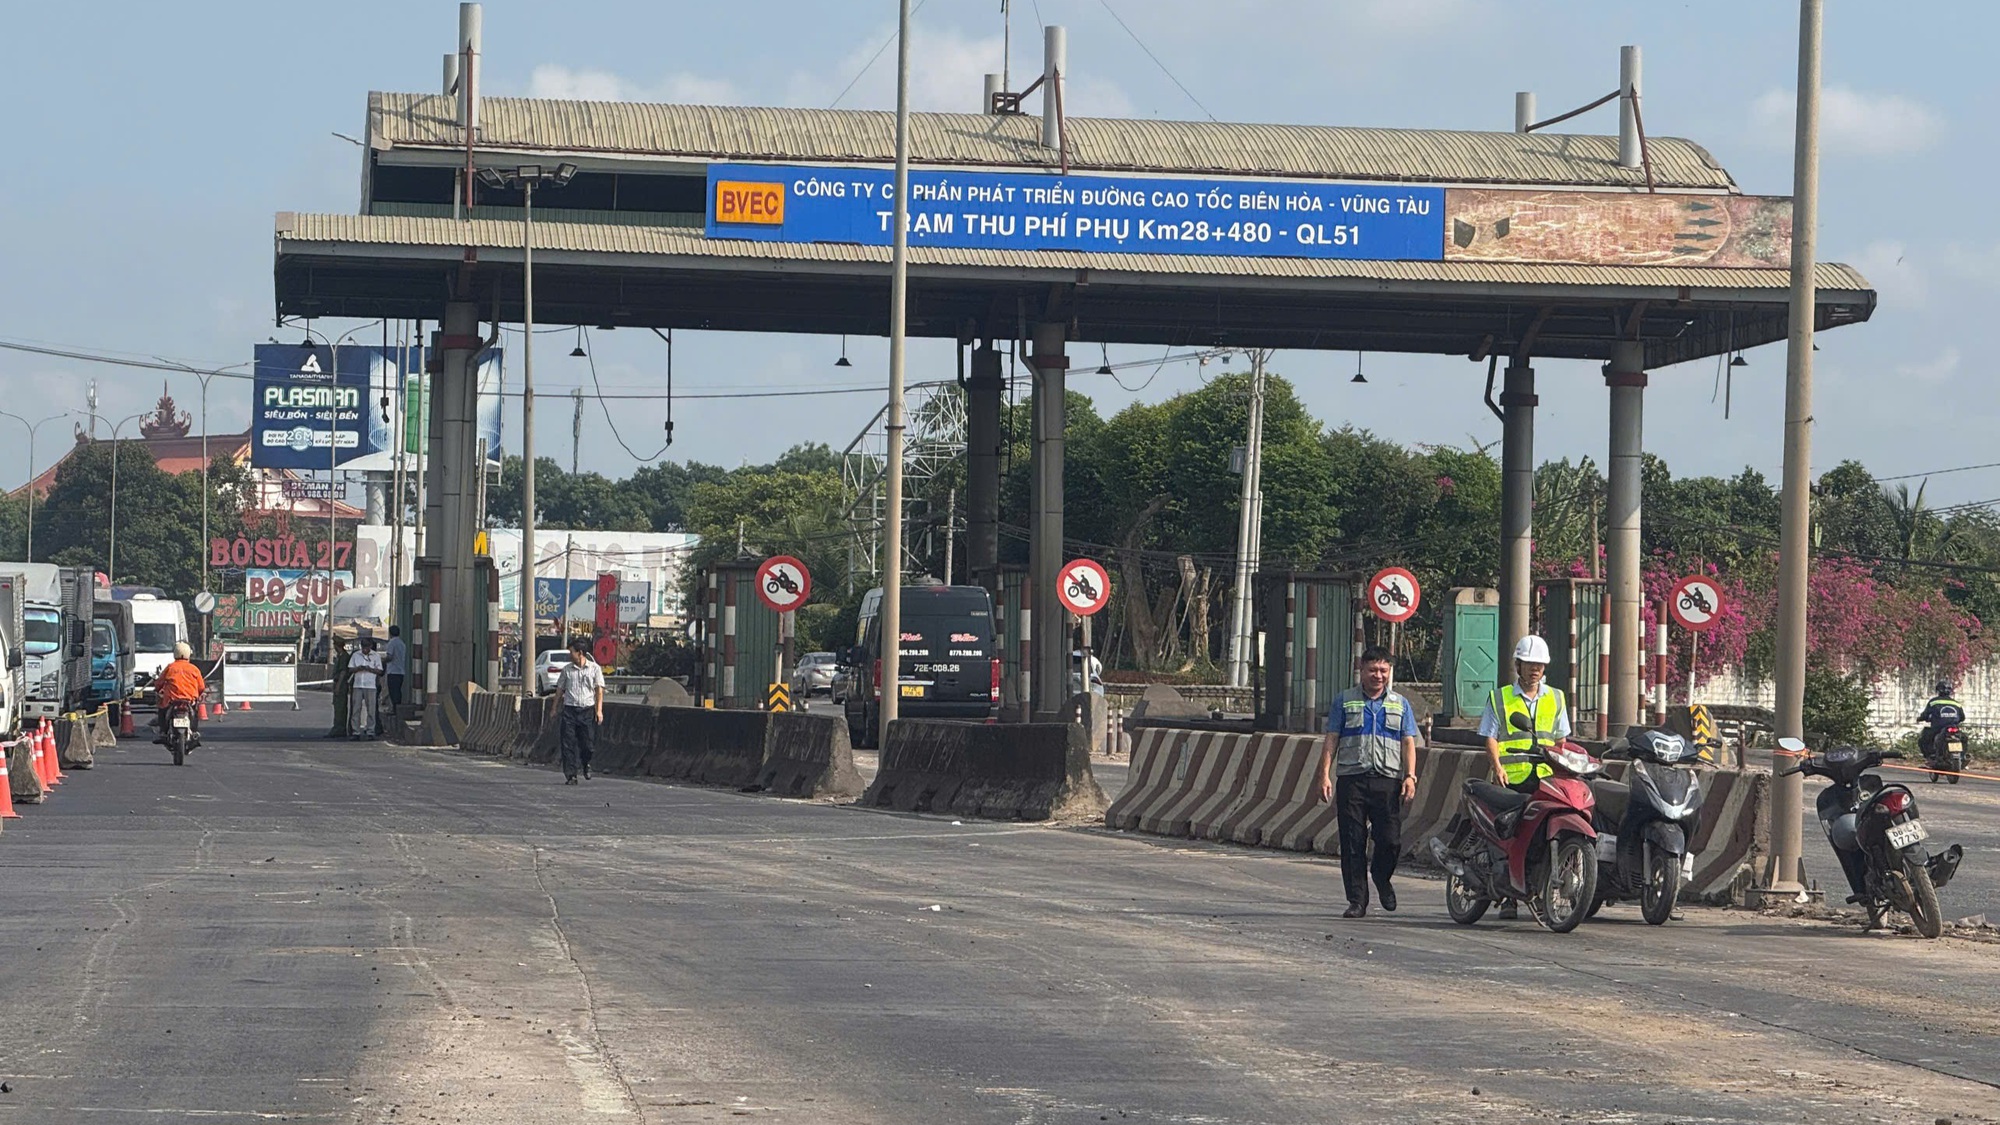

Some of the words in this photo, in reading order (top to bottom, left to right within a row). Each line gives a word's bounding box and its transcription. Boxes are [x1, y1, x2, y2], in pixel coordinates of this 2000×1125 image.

[722, 190, 779, 215] BVEC
[793, 177, 845, 198] CÔNG
[852, 182, 874, 198] TY
[913, 179, 962, 201] PHẦN
[968, 183, 1016, 203] PHÁT
[1023, 182, 1075, 205] TRIỂN
[1081, 187, 1146, 207] ĐƯỜNG
[1151, 191, 1189, 209] CAO
[1196, 186, 1233, 210] TỐC
[1239, 191, 1280, 211] BIÊN
[1286, 191, 1323, 212] HÒA
[1340, 194, 1390, 214] VŨNG
[1396, 196, 1430, 215] TÀU
[962, 213, 1016, 236] THU
[1024, 211, 1068, 237] PHÍ
[1075, 217, 1130, 245] PHỤ
[1138, 219, 1272, 243] Km28+480
[1296, 223, 1359, 245] QL51
[265, 387, 359, 407] PLASMAN
[210, 532, 251, 566] BÒ
[254, 533, 311, 567] SỮA
[316, 540, 352, 567] 27
[246, 609, 290, 627] LONG
[914, 664, 960, 672] 72E-008.26
